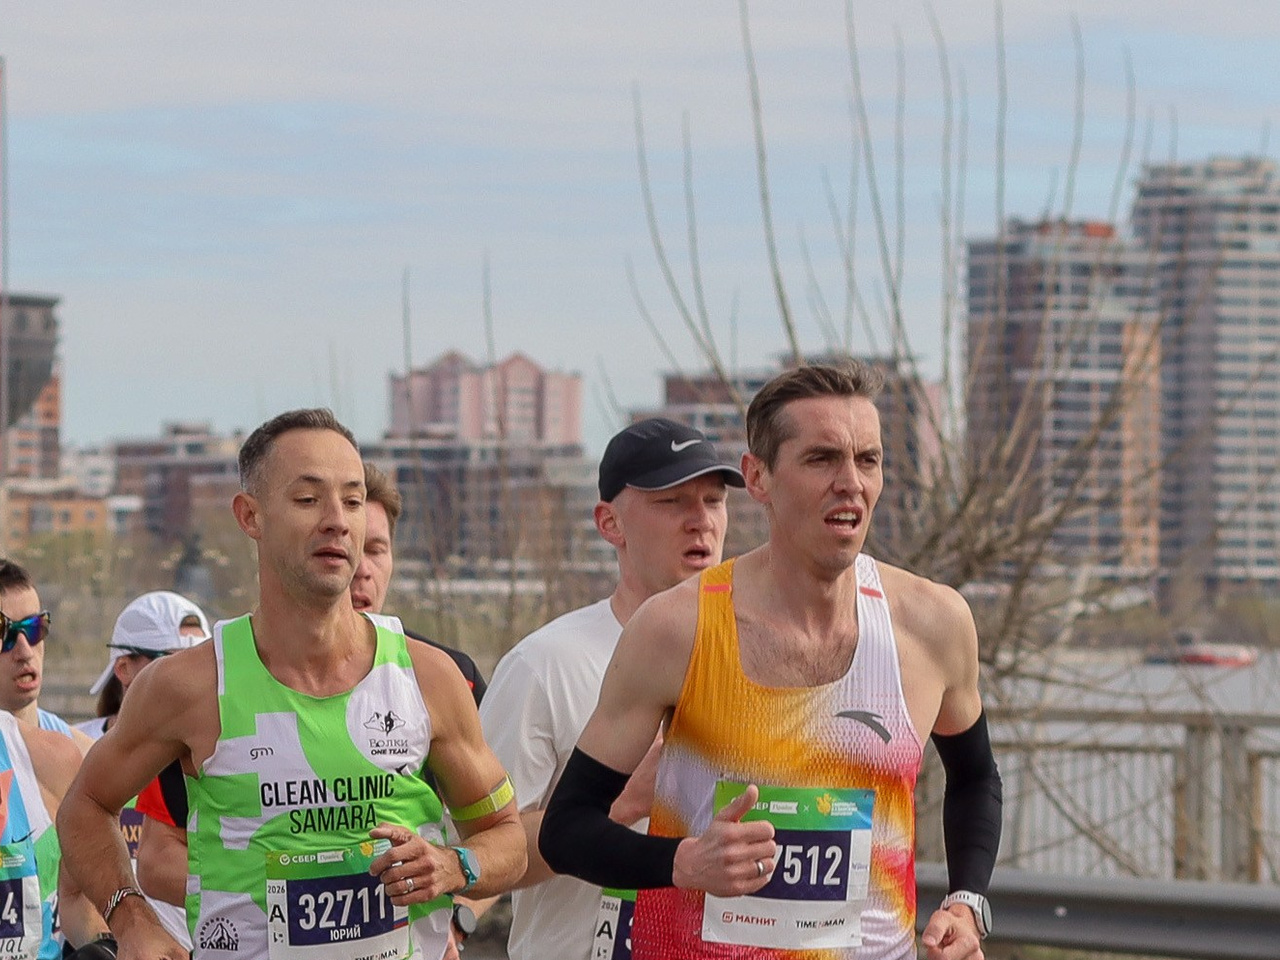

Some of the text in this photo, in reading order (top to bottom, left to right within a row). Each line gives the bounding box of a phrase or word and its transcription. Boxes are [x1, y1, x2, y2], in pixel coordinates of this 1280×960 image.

[261, 773, 395, 807] CLEAN CLINIC
[289, 803, 377, 834] SAMARA
[292, 855, 316, 863] СБЕР
[268, 886, 285, 894] 2026
[269, 904, 286, 923] A
[298, 883, 385, 931] 32711
[601, 901, 619, 911] 2026
[735, 914, 777, 927] МАГНИТ
[330, 924, 361, 941] ЮРИЙ
[596, 920, 613, 940] A
